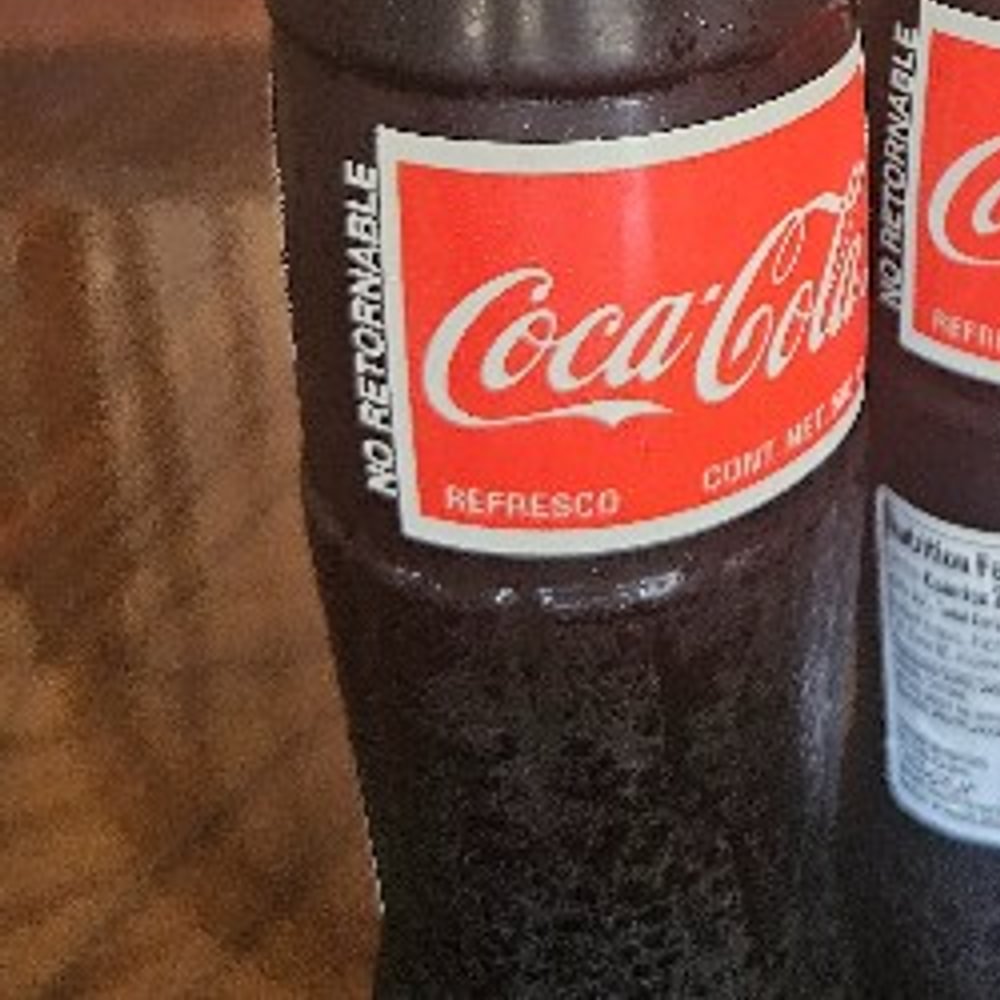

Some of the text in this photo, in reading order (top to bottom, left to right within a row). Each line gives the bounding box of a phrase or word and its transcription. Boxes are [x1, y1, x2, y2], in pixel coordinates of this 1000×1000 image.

[880, 21, 920, 311] NO RETORNABLE
[344, 160, 399, 498] NO RETORNABLE
[445, 486, 621, 520] REFRESCO
